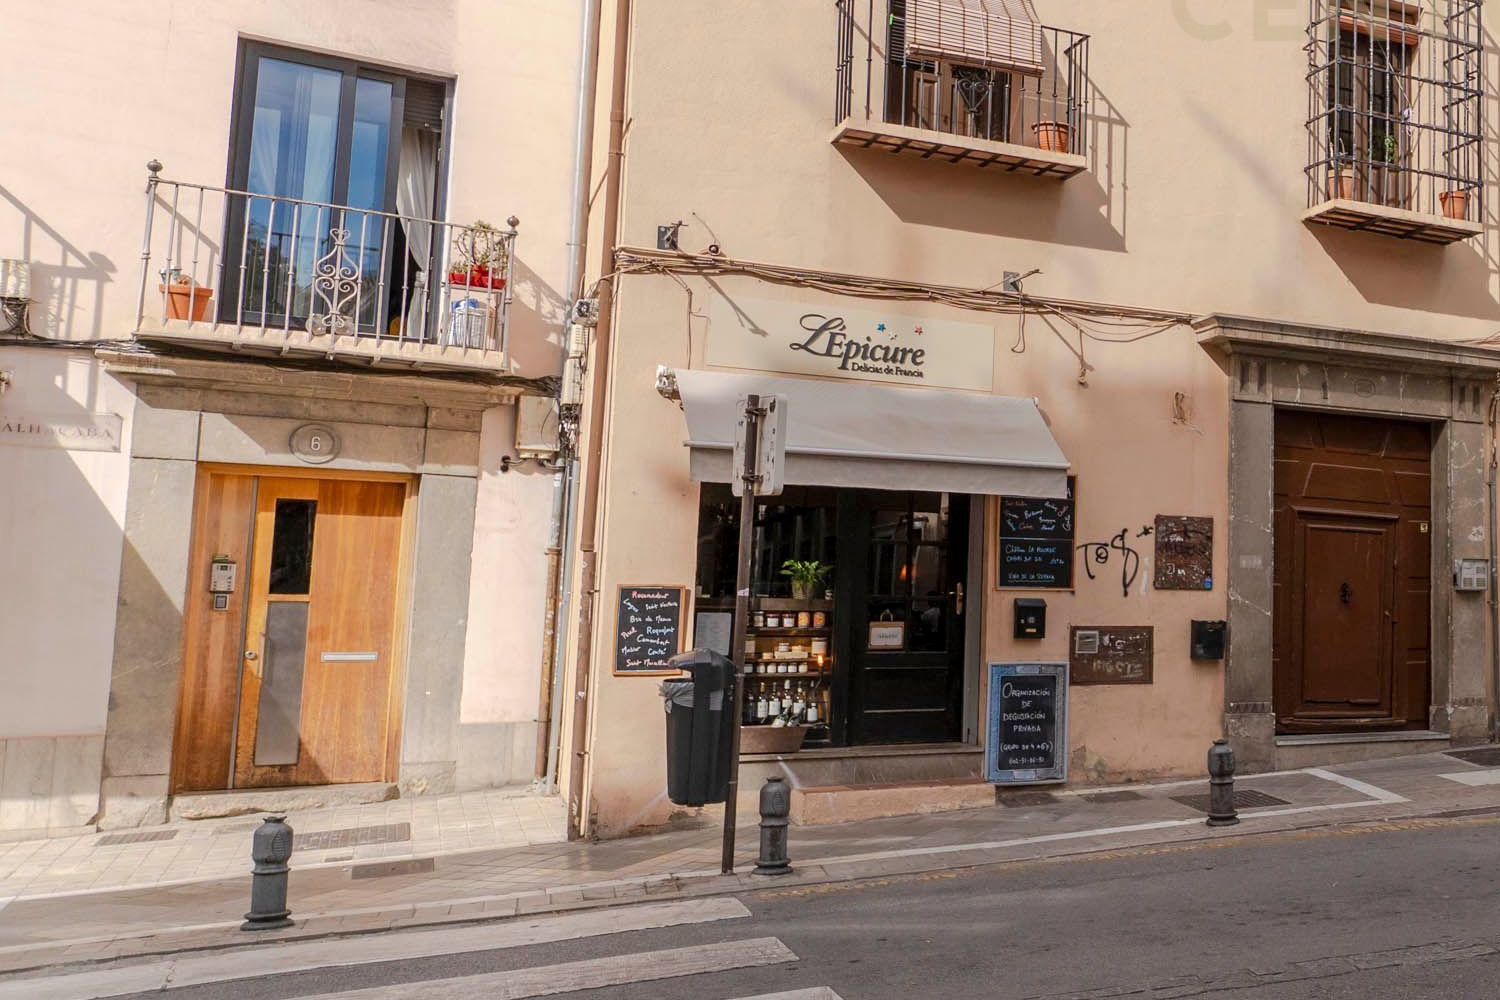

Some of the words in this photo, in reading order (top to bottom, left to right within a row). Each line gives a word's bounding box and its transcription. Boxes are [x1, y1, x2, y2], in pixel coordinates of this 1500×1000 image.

[851, 362, 882, 374] Delicias
[883, 365, 893, 375] de
[895, 366, 923, 377] Francia
[311, 436, 320, 451] 6
[1021, 700, 1032, 708] DE
